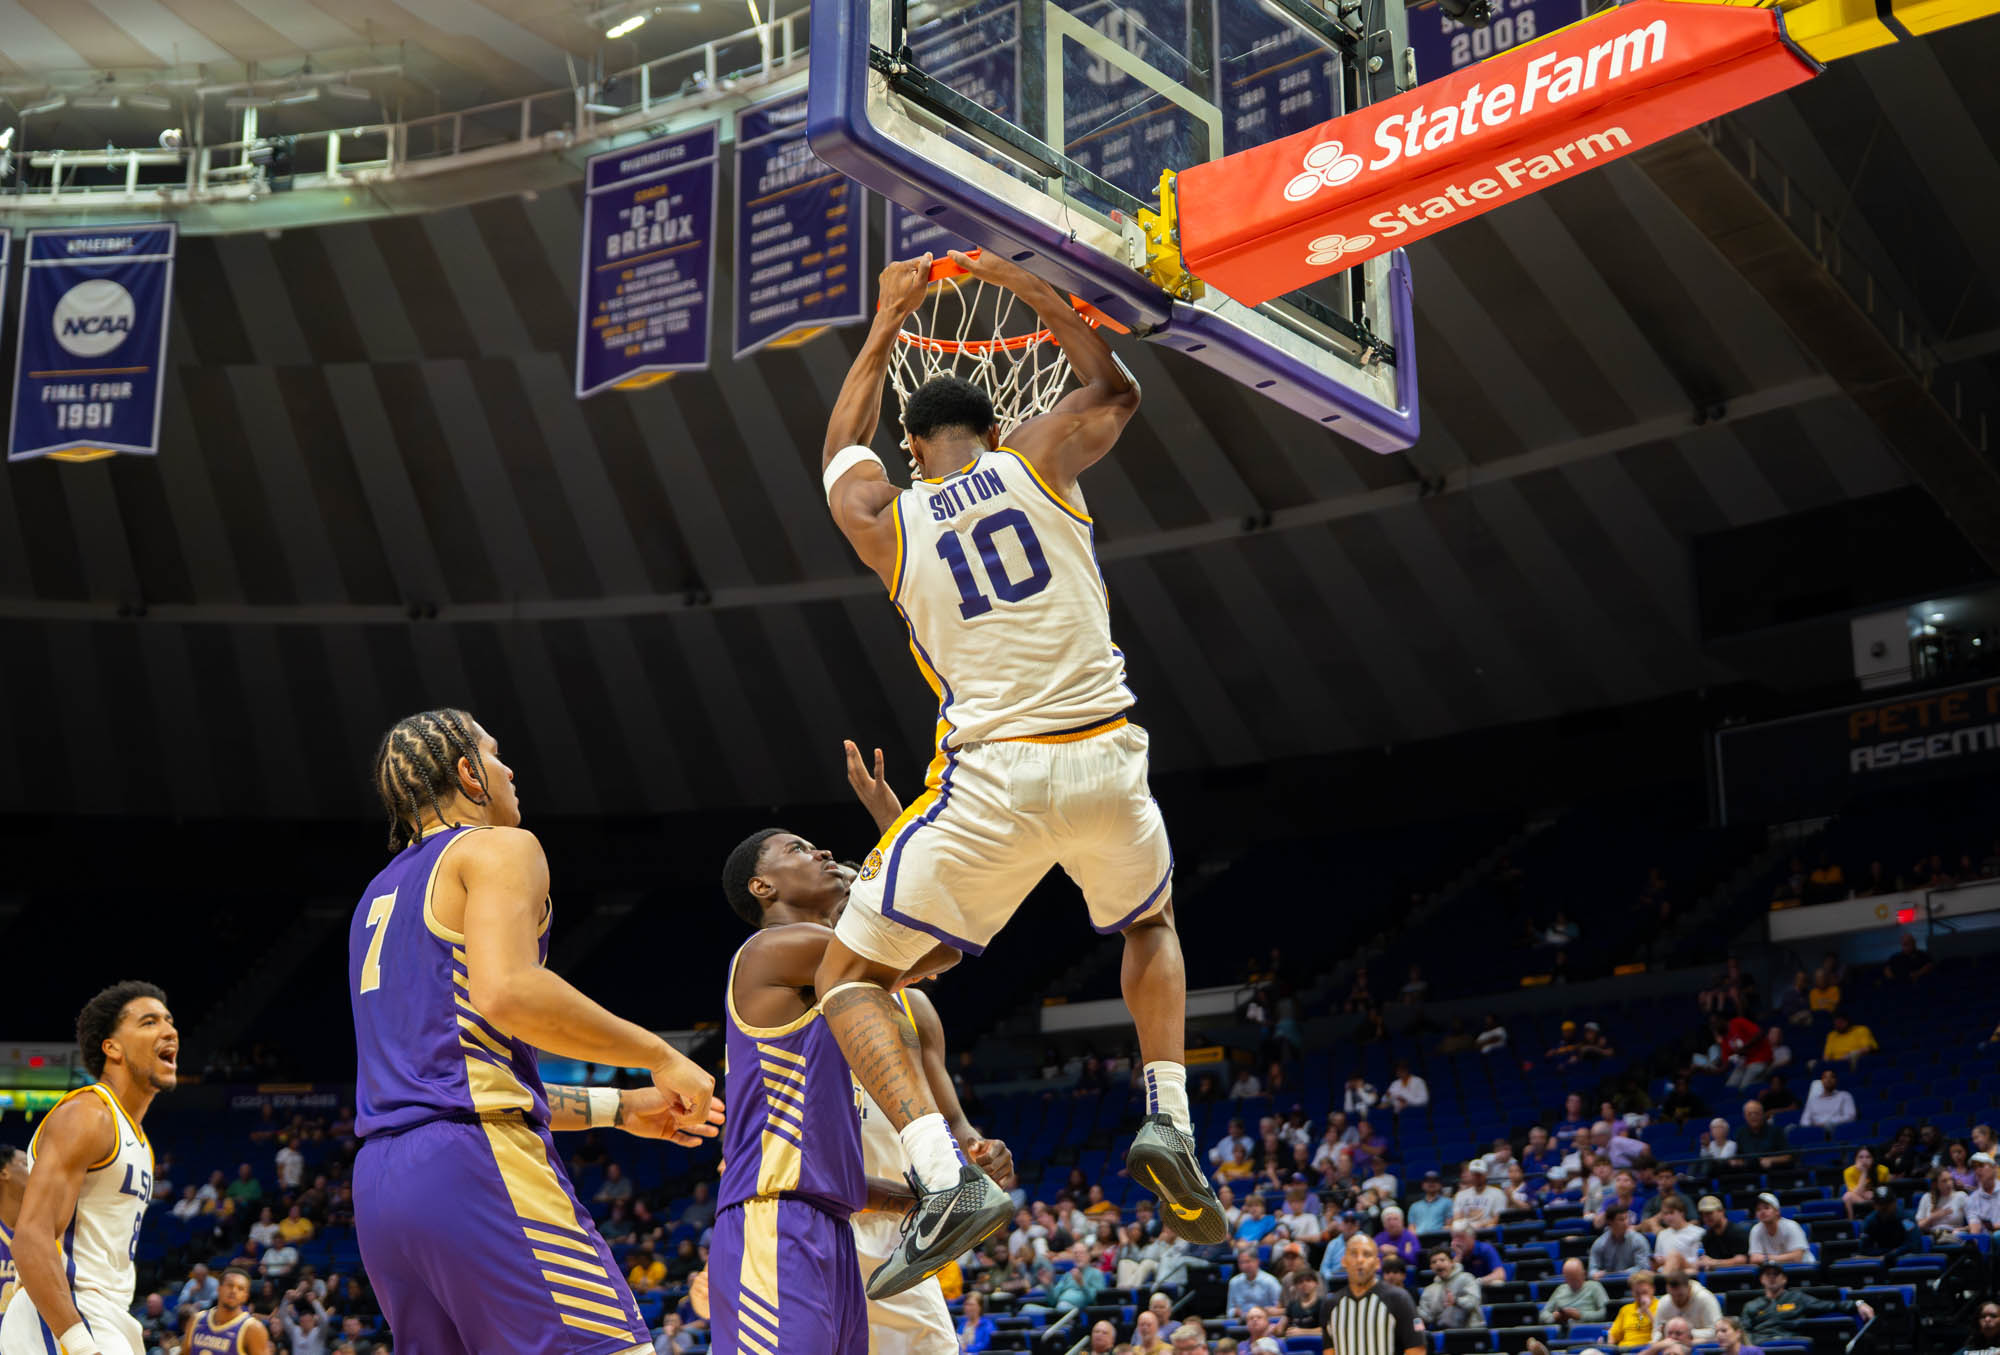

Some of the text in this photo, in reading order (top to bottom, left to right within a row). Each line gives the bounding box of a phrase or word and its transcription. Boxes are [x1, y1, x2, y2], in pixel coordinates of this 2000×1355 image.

[1450, 9, 1537, 67] 2008
[606, 214, 694, 259] BREAUX
[62, 315, 130, 336] NCAA
[41, 382, 133, 402] FINAL FOUR
[57, 403, 114, 429] 1991
[928, 467, 1007, 521] SUTTON
[935, 507, 1053, 621] 10
[1848, 690, 1969, 744] PETE
[359, 885, 399, 995] 7
